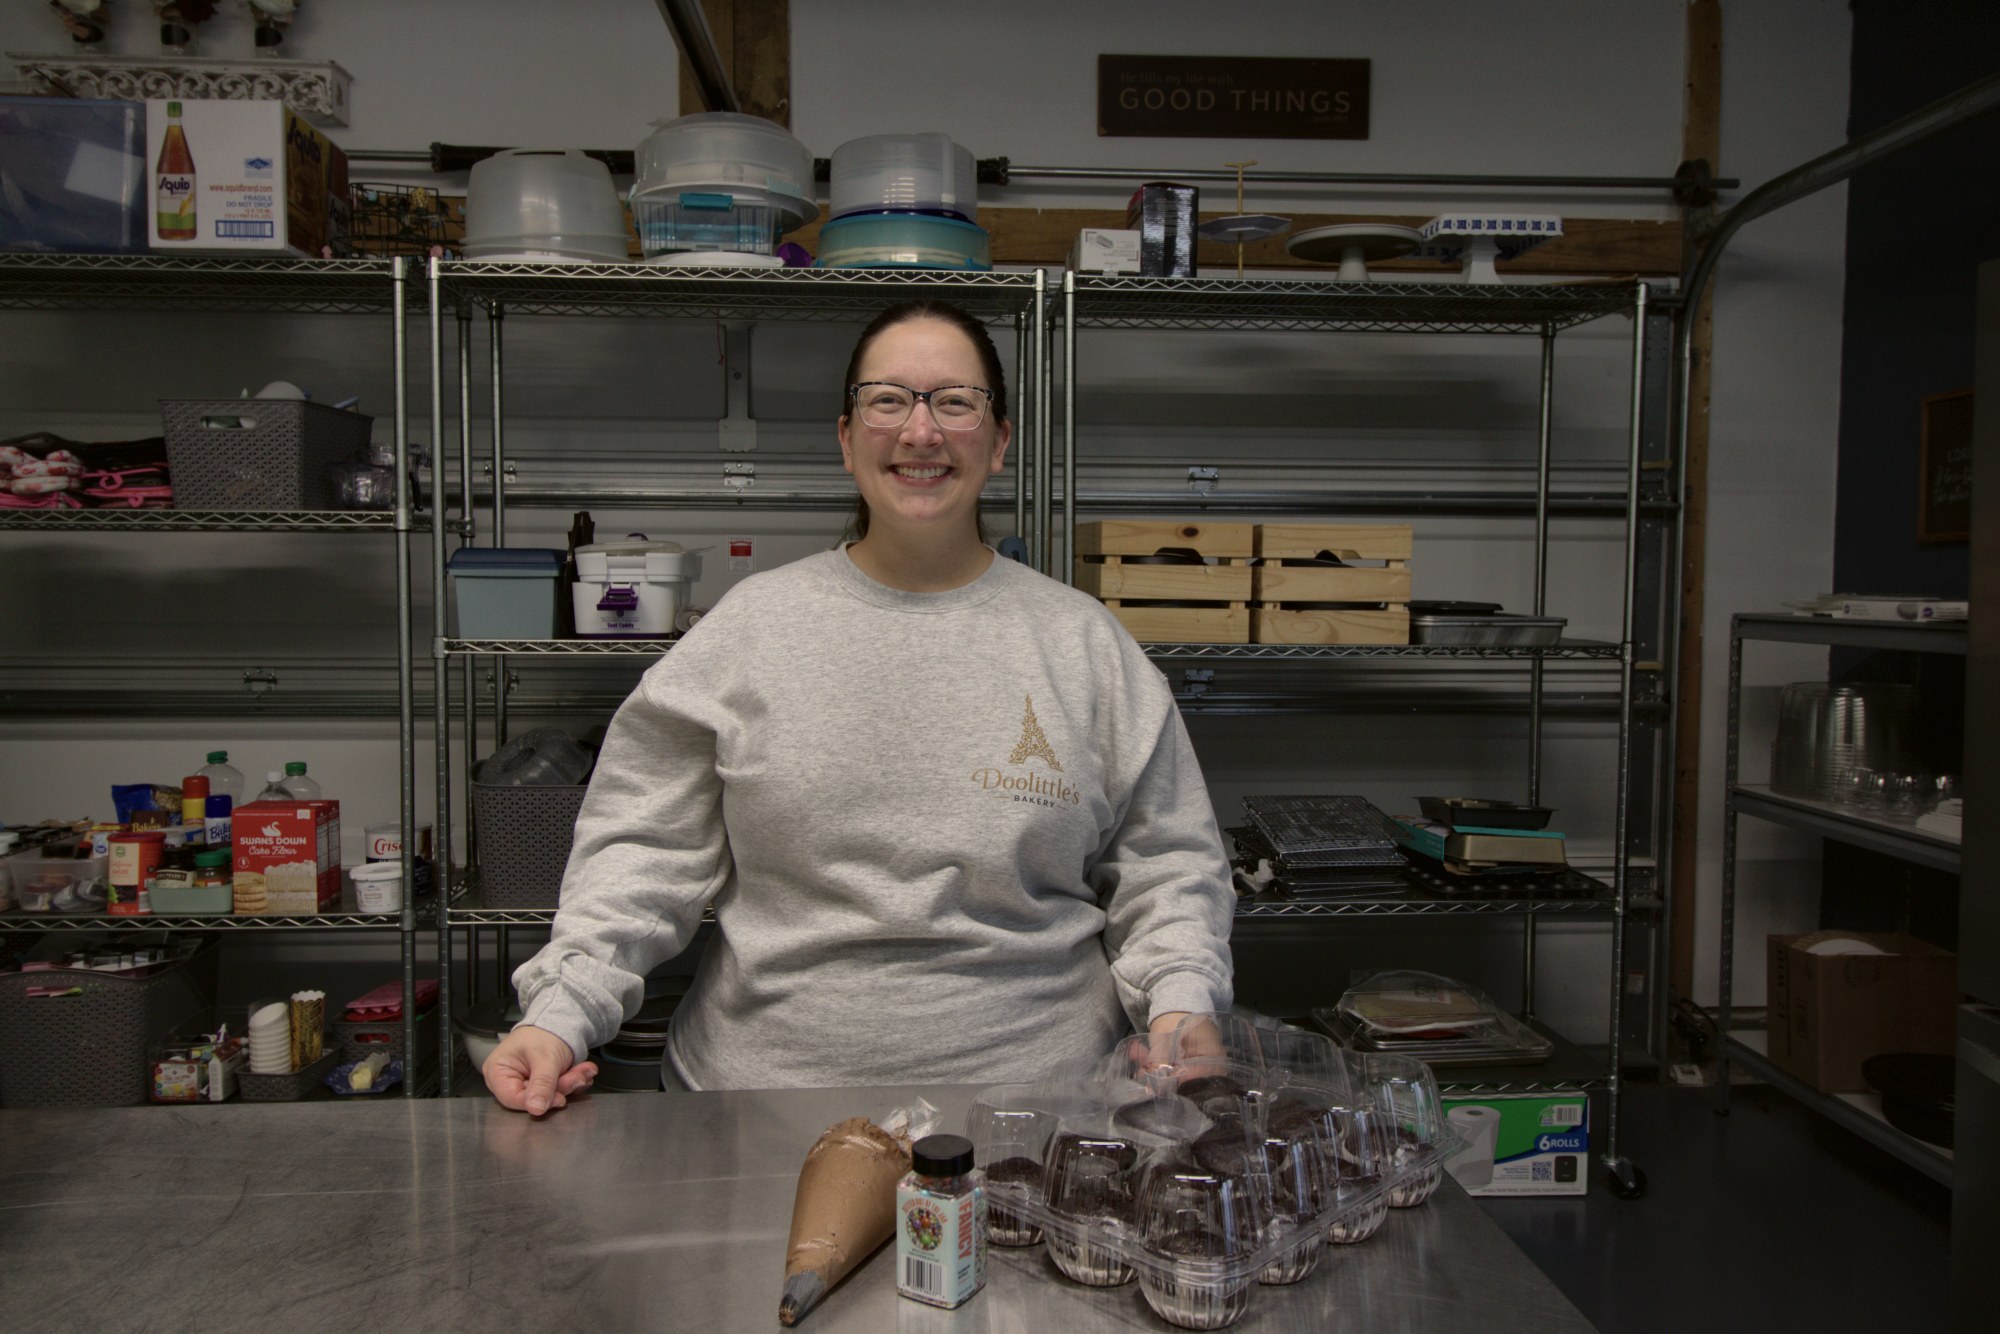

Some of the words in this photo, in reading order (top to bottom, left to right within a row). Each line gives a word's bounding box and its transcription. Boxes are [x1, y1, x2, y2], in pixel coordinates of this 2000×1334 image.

[1207, 73, 1234, 85] with
[1119, 88, 1216, 111] GOOD
[1229, 89, 1351, 113] THINGS
[618, 622, 634, 630] Caddy
[971, 767, 1080, 805] Doolittle's
[1014, 794, 1055, 807] BAKERY
[239, 837, 274, 845] SWANS
[275, 837, 307, 845] DOWN
[248, 845, 271, 855] Cake
[271, 845, 298, 855] Flour
[1539, 1135, 1550, 1151] 6
[1550, 1139, 1580, 1148] ROLLS
[959, 1199, 973, 1260] FANCY
